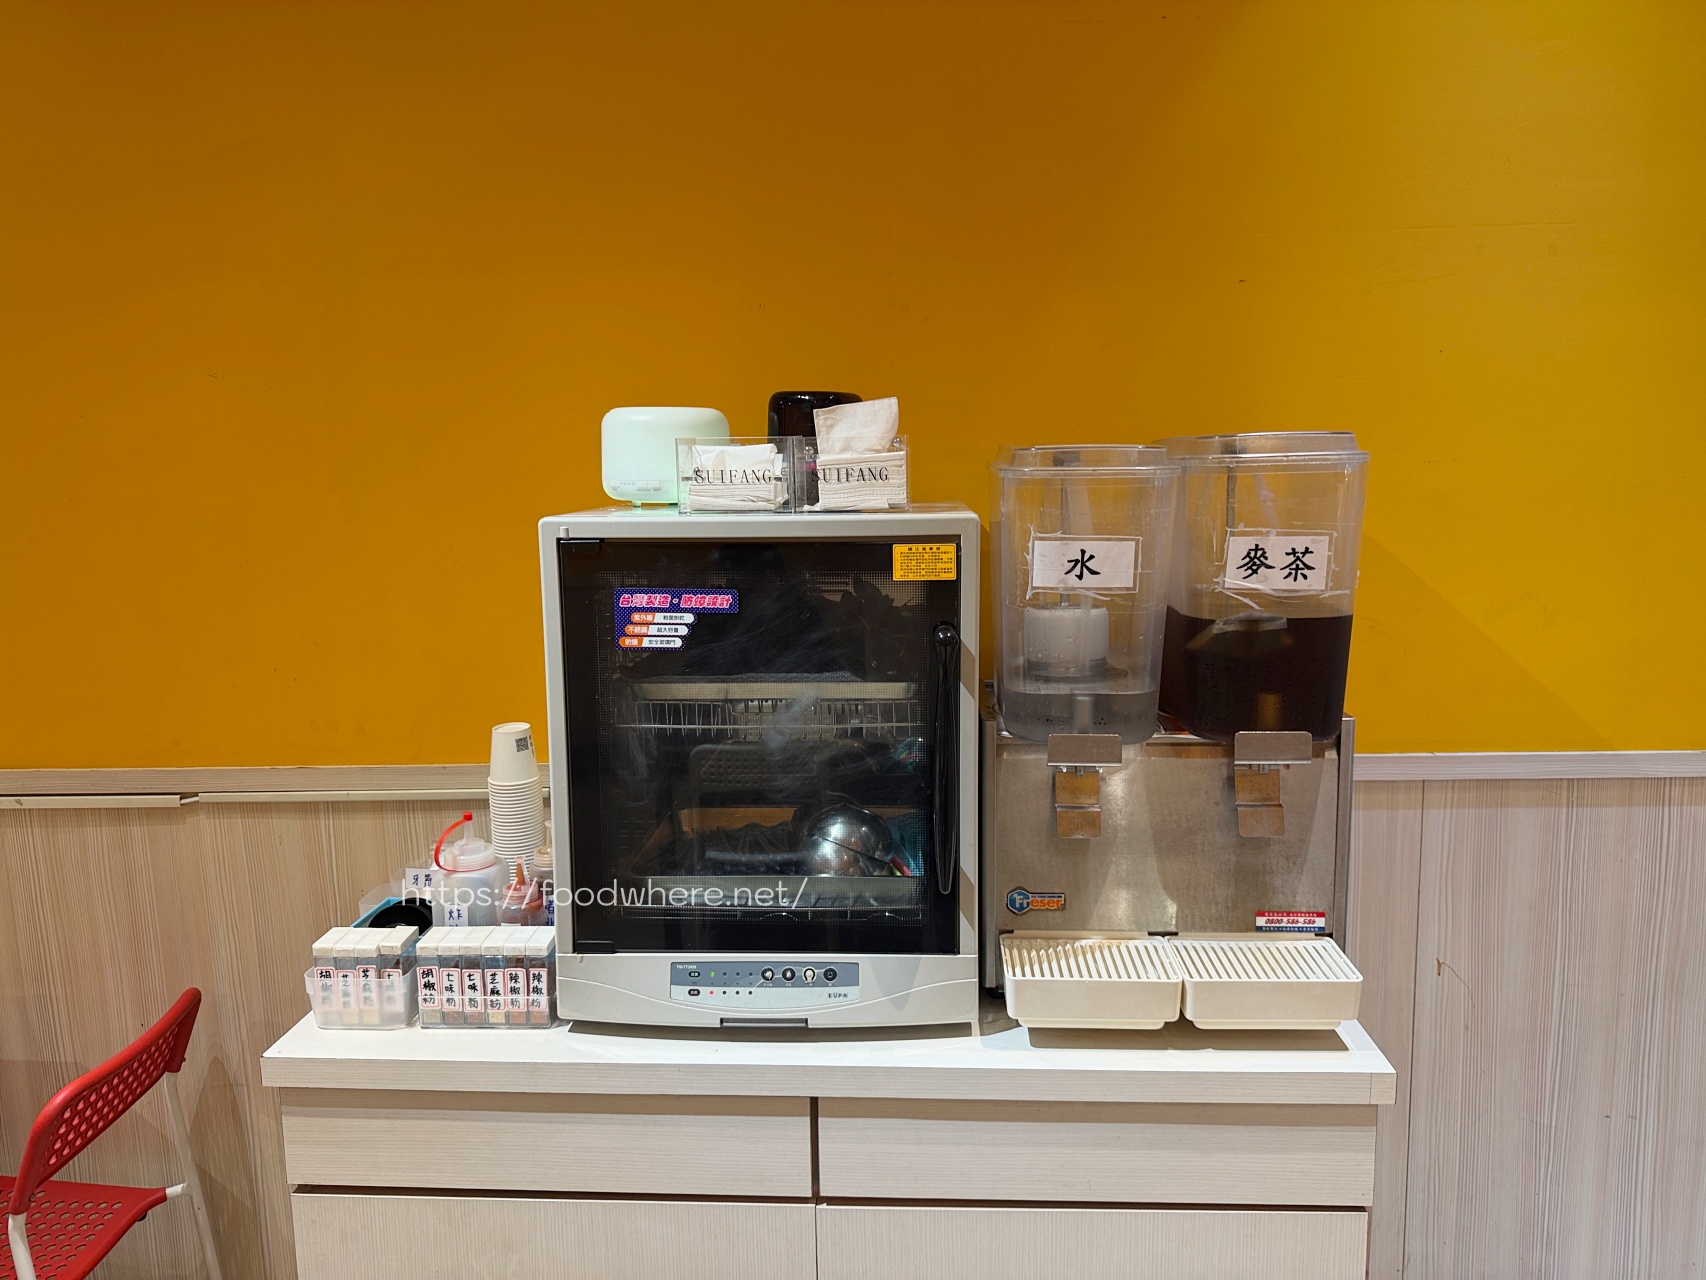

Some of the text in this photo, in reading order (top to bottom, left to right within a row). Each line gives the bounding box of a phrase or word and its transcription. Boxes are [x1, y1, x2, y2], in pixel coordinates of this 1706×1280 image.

[696, 469, 772, 484] SUIFANG
[812, 467, 889, 482] SUIFANG
[1064, 548, 1101, 581] 水
[1236, 543, 1316, 583] 麥茶
[420, 968, 437, 1005] 胡椒粉
[489, 972, 502, 1010] 芝麻粉
[508, 972, 521, 1009] 辣椒粉
[530, 972, 545, 1009] 辣椒粉
